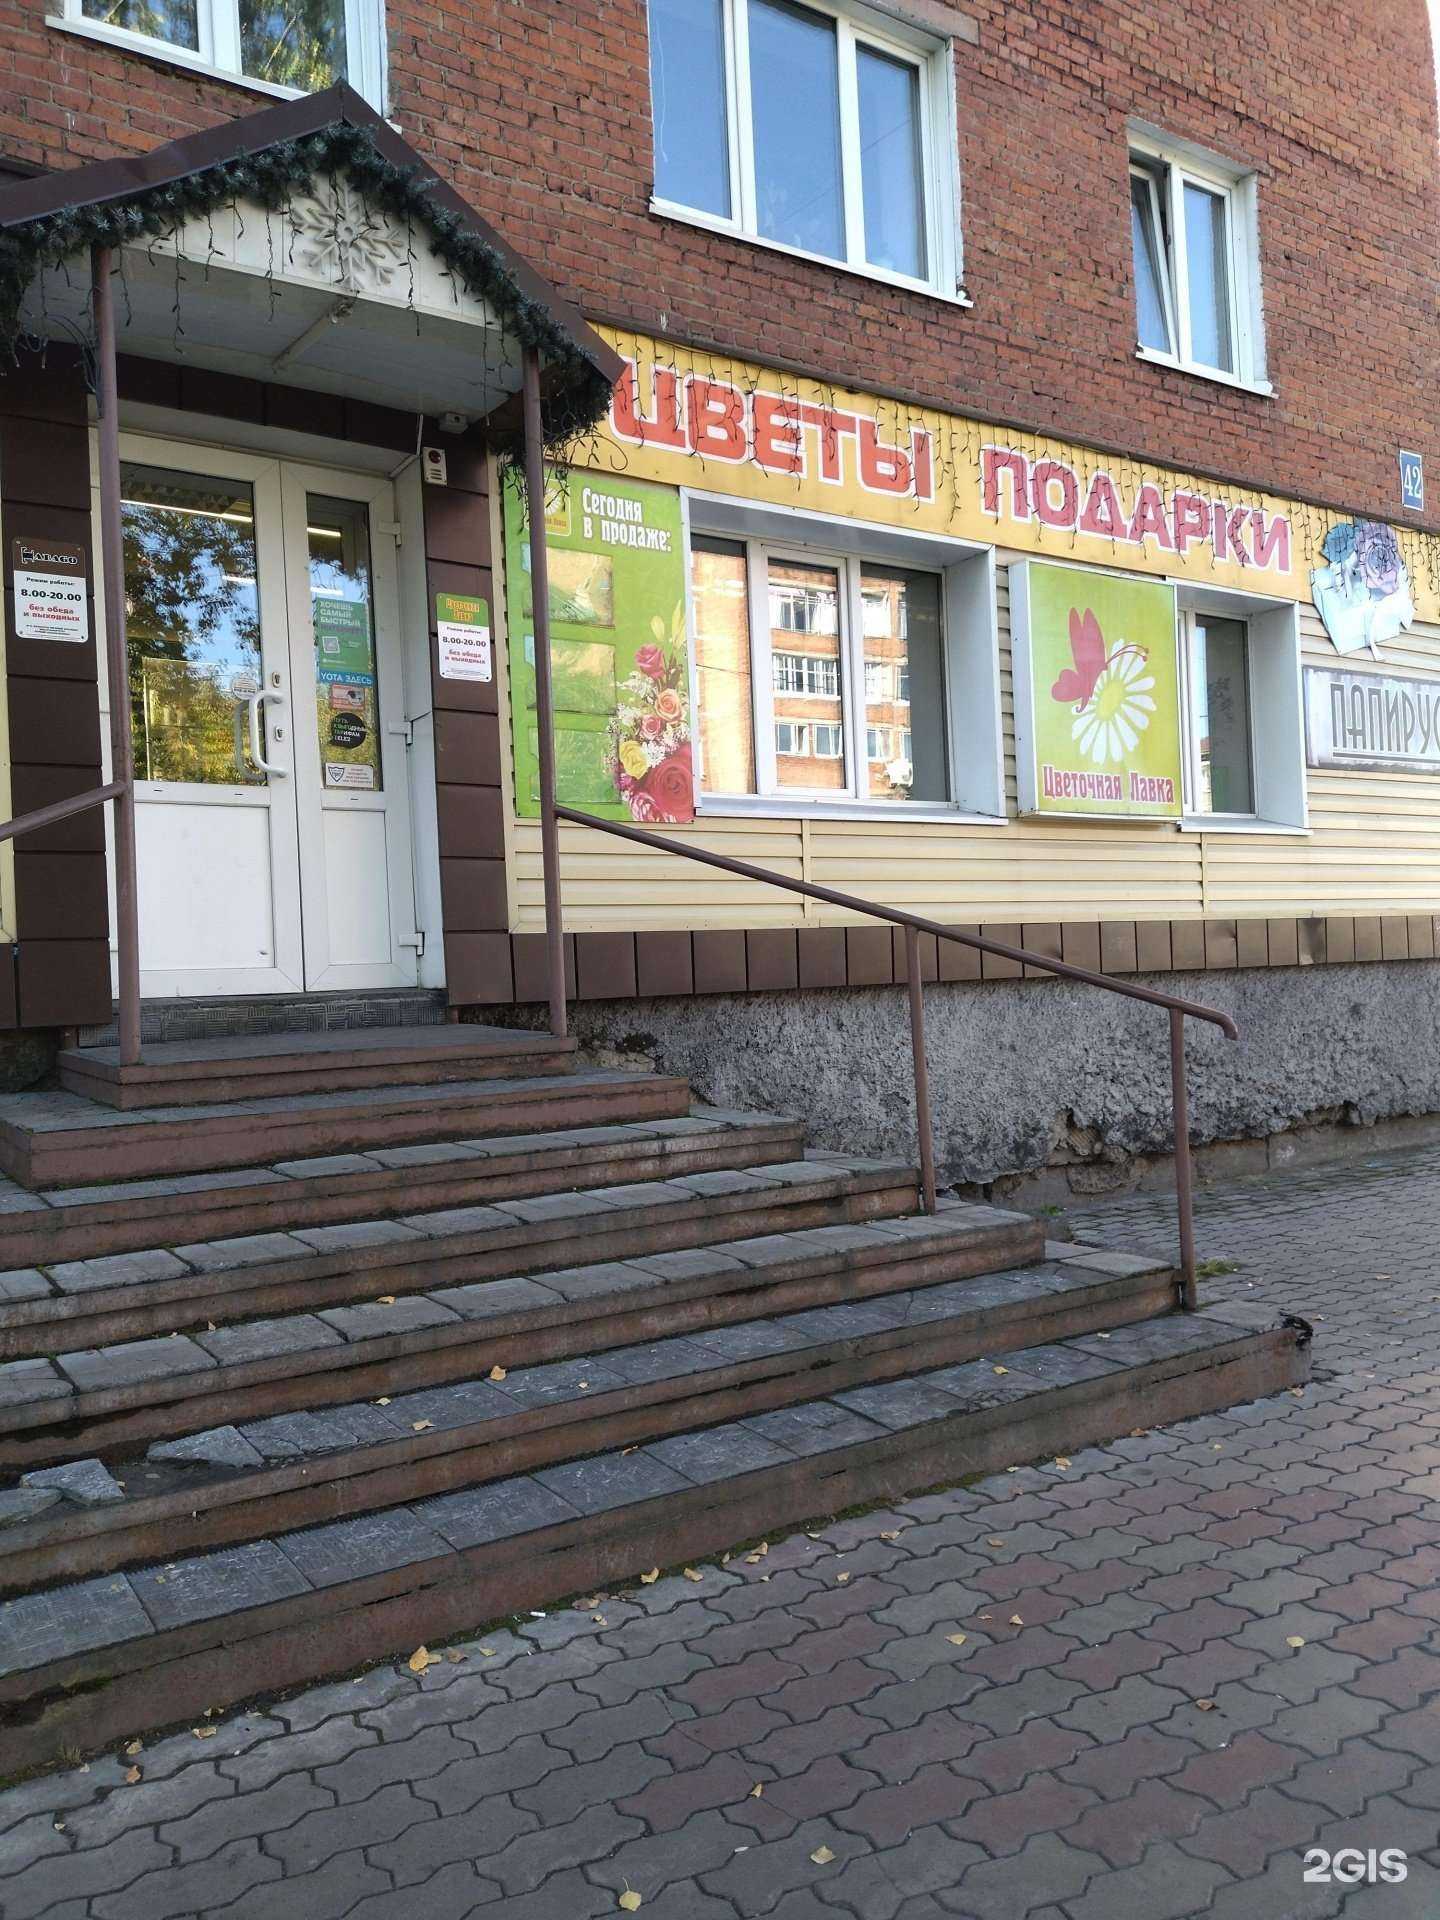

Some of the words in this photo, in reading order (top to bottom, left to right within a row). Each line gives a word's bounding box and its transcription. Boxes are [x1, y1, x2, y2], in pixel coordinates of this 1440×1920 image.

[610, 356, 935, 503] ЦВЕТЫ
[983, 445, 1292, 576] ПОДАРКИ
[1404, 464, 1421, 499] 42
[582, 487, 643, 523] Сегодня
[601, 520, 672, 552] продаже:
[21, 588, 82, 602] 8.00-20.00
[29, 603, 45, 612] без
[47, 605, 74, 615] обеда
[32, 612, 81, 622] выходных
[442, 636, 487, 648] 8.00-20.00
[345, 674, 372, 685] ЗДЕСЬ
[1043, 765, 1123, 801] Цветочная
[1130, 771, 1175, 803] Лавка
